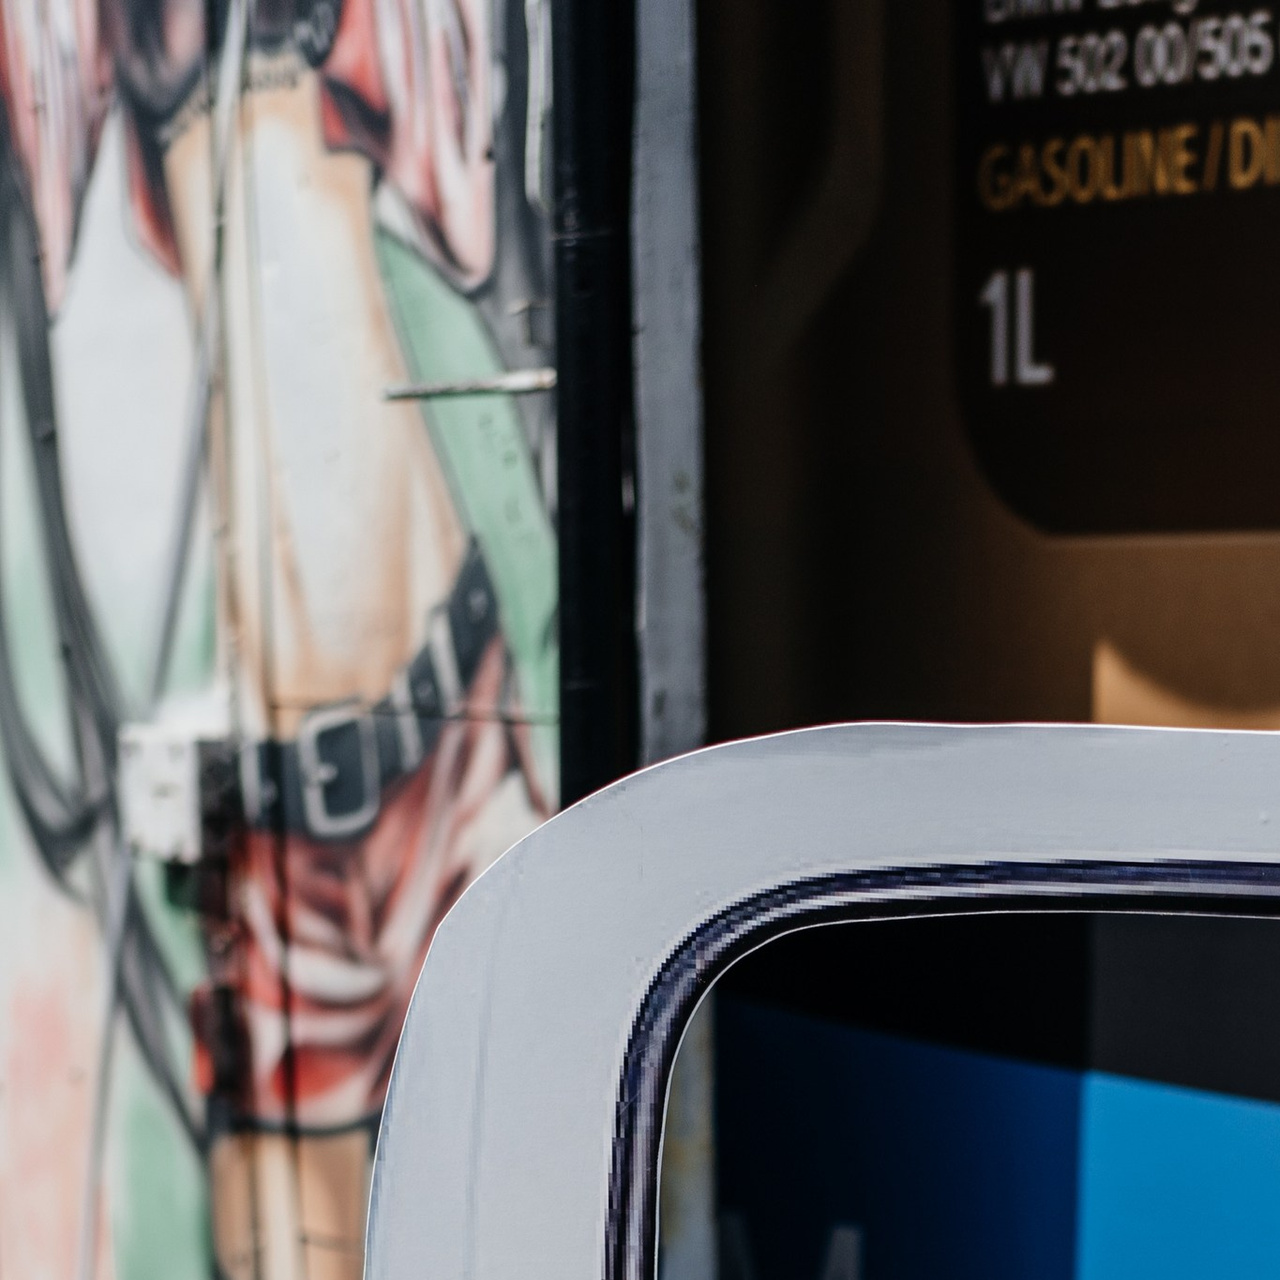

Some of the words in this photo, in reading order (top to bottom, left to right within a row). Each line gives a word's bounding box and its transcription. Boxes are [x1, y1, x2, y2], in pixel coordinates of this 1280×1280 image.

[982, 42, 1048, 99] VW
[1056, 30, 1128, 94] 502
[1135, 10, 1273, 86] 00/505
[980, 269, 1055, 386] 1L
